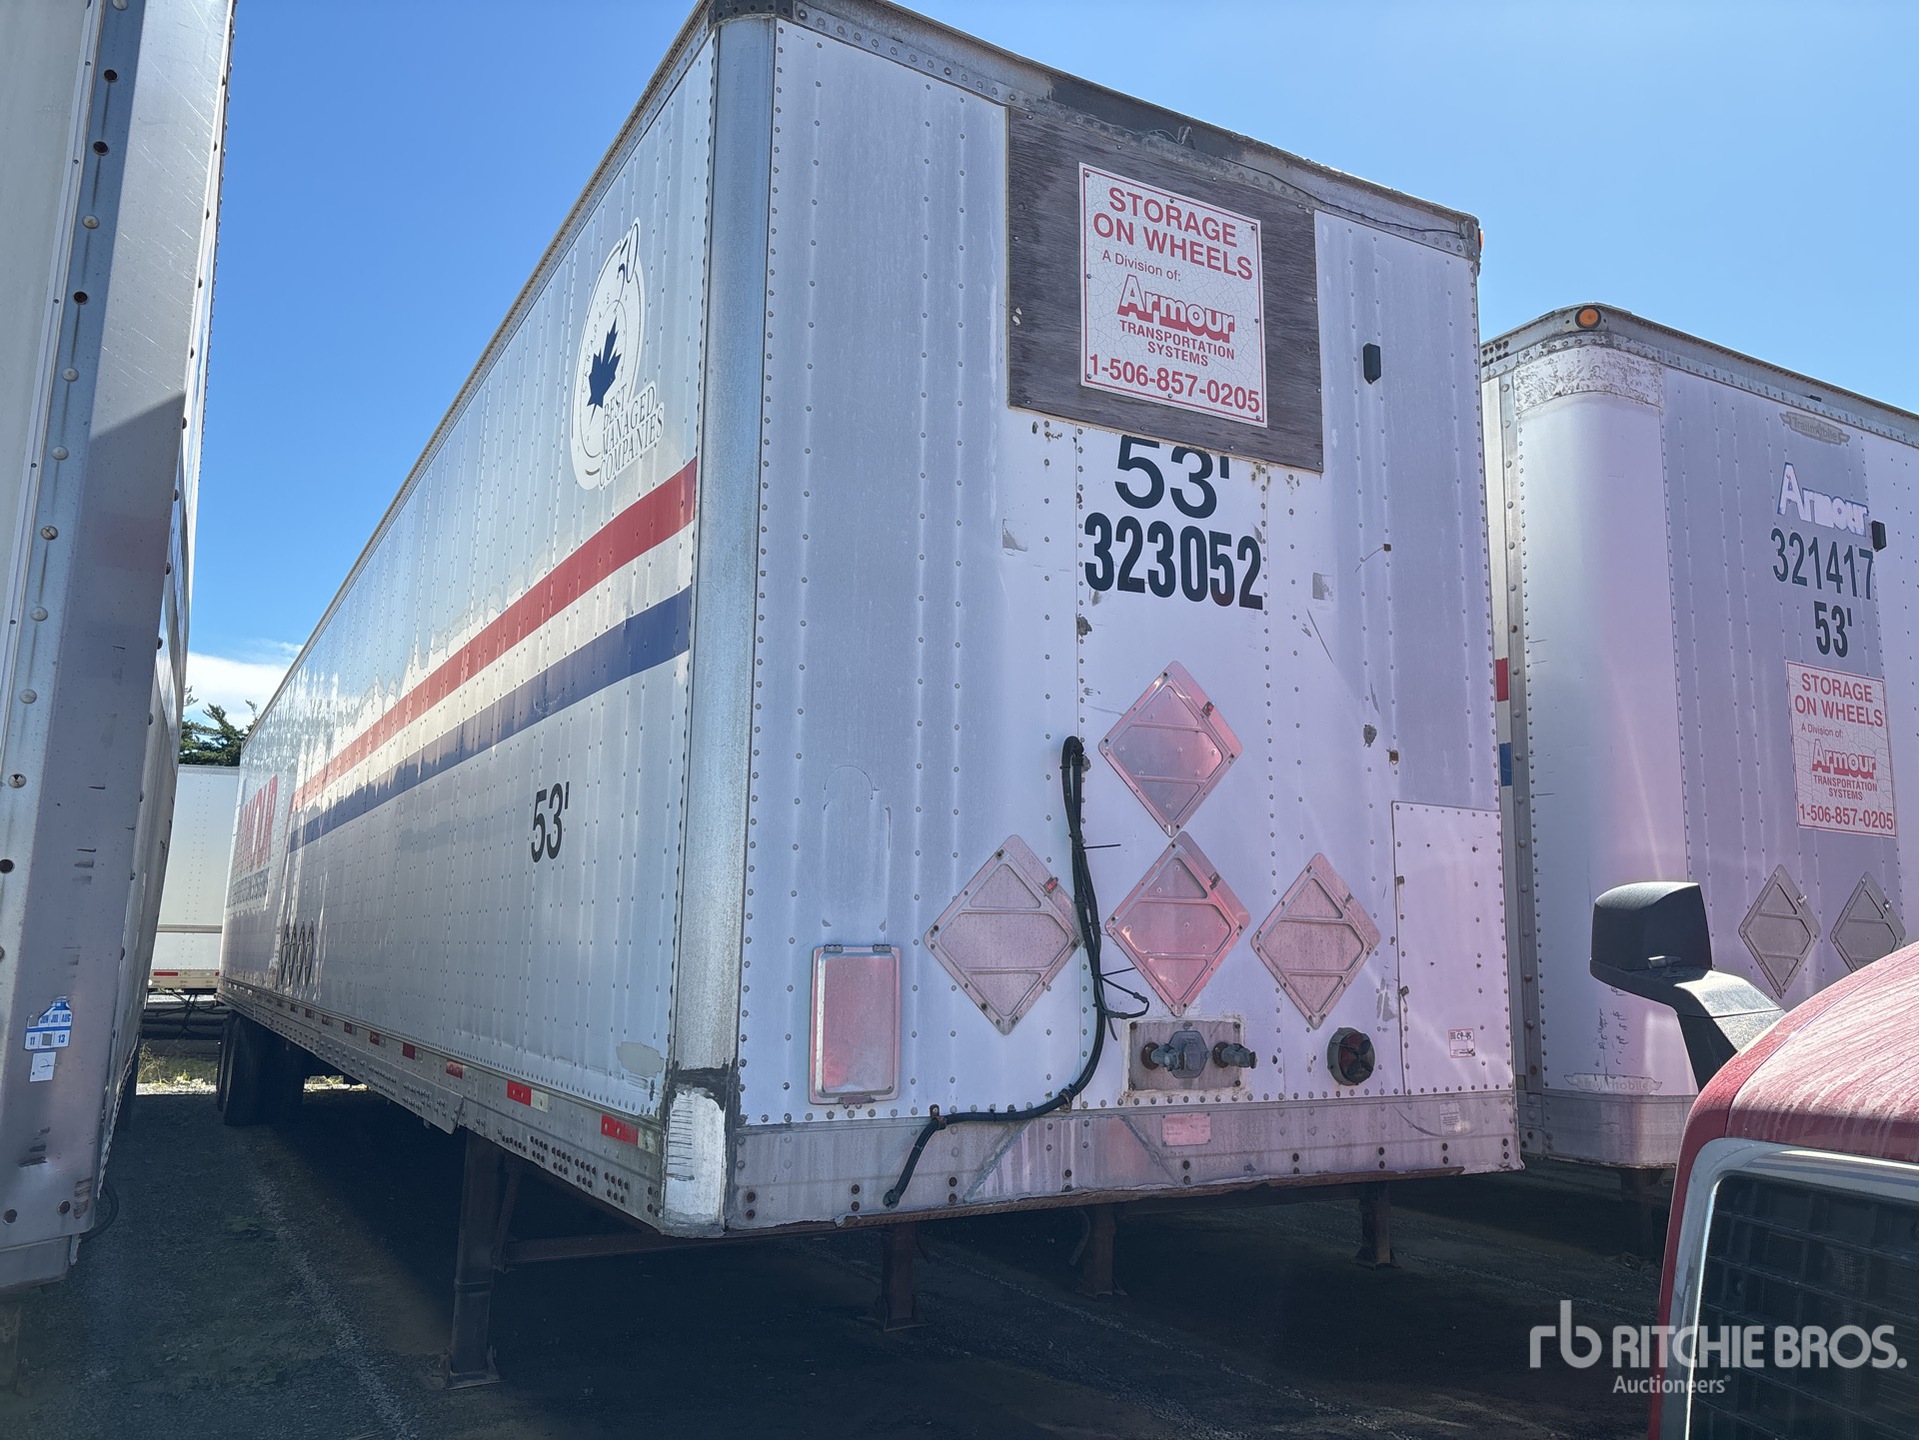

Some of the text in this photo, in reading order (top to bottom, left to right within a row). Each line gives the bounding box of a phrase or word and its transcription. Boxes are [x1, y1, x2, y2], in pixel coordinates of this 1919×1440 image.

[1109, 187, 1237, 247] STORAGE
[1093, 213, 1253, 280] ON WHEELS
[1102, 250, 1181, 282] A Division of:
[1117, 274, 1235, 343] Armour
[1120, 320, 1235, 360] TRANSPORTATION
[1147, 341, 1208, 367] SYSTEMS
[1090, 354, 1260, 413] 1-506-857-0205
[603, 383, 627, 431] BEST
[600, 407, 663, 487] COMPANIES
[1114, 434, 1230, 519] 53'
[1084, 512, 1263, 610] 323052
[1770, 528, 1874, 600] 321417
[1813, 600, 1853, 658] 53'
[1801, 672, 1874, 703] STORAGE
[1794, 694, 1884, 727] ON WHEELS
[1801, 723, 1844, 739] A Division of:
[1812, 739, 1877, 780] Armour
[1813, 775, 1878, 792] TRANSPORTATION
[1828, 788, 1863, 801] SYSTEMS
[531, 781, 570, 863] 53'
[1799, 803, 1894, 830] 1-506-857-0205
[58, 1034, 66, 1044] 13
